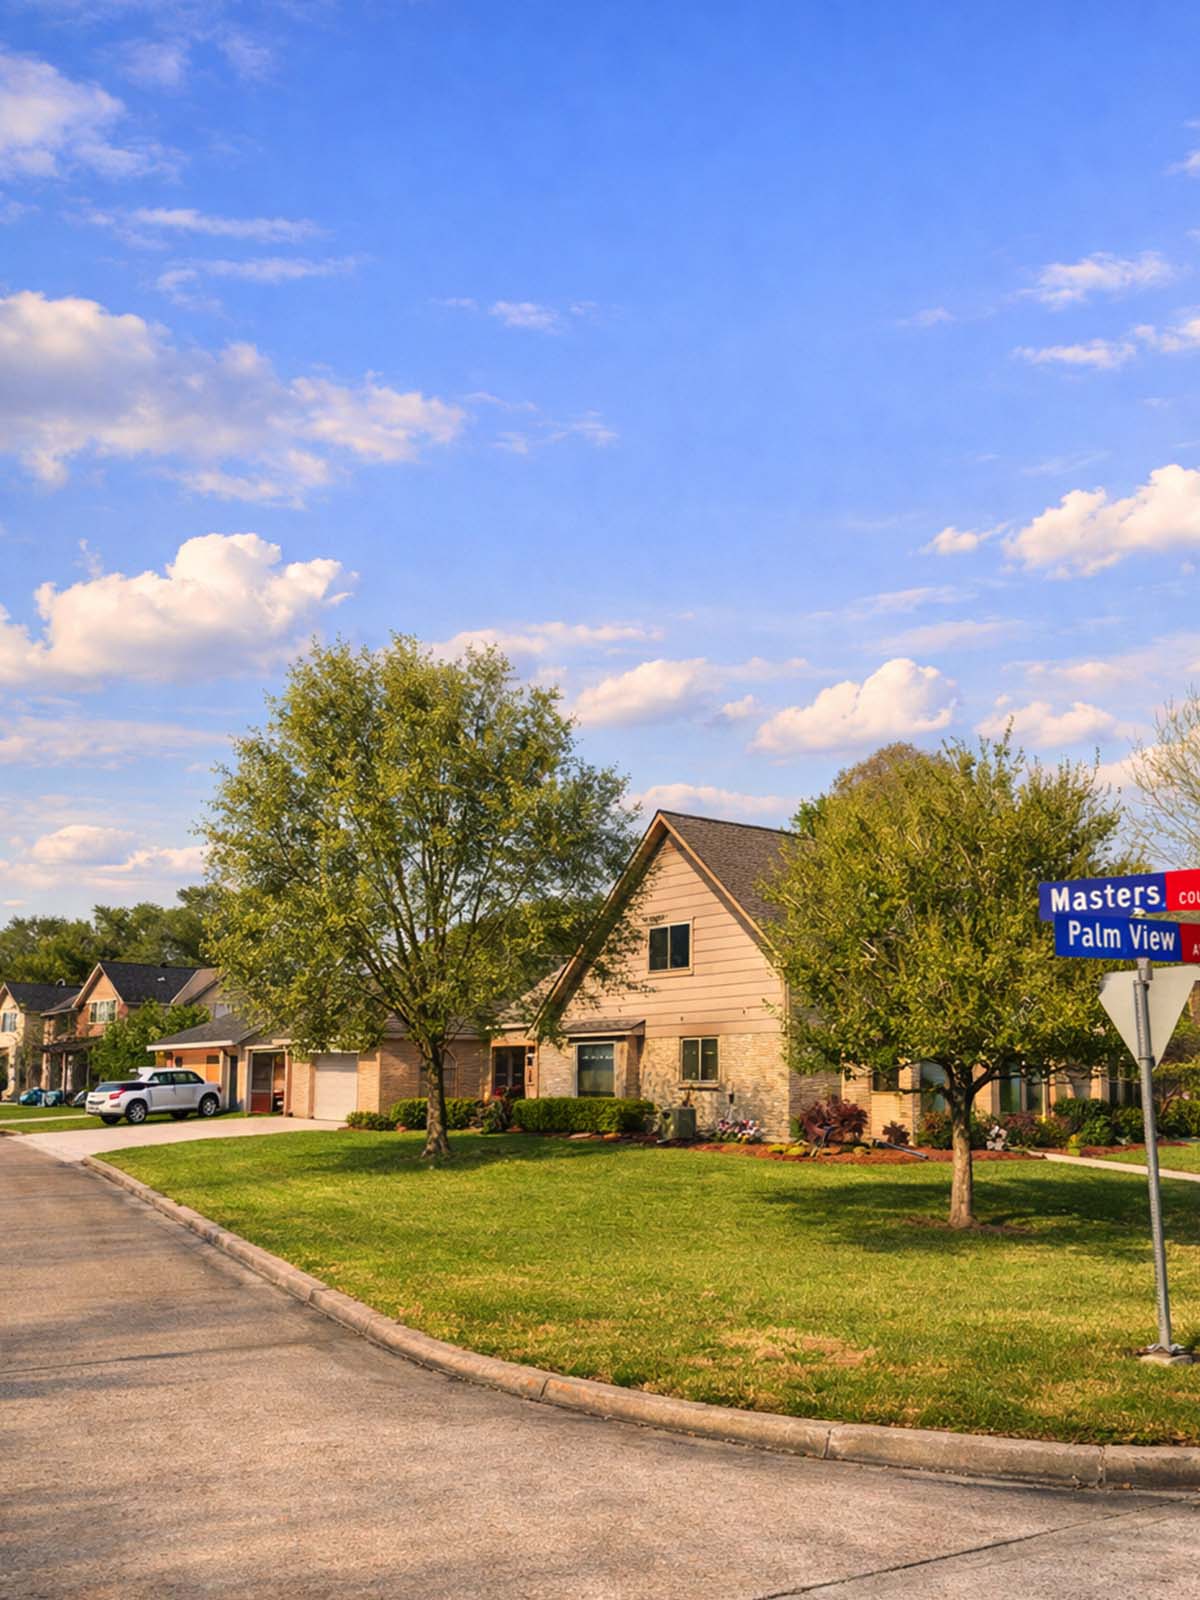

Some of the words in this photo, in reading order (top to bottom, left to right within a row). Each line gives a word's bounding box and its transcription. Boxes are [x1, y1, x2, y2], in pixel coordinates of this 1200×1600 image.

[1051, 884, 1161, 912] Masters
[1068, 920, 1121, 948] Palm
[1129, 923, 1175, 951] View
[1192, 943, 1200, 956] A
